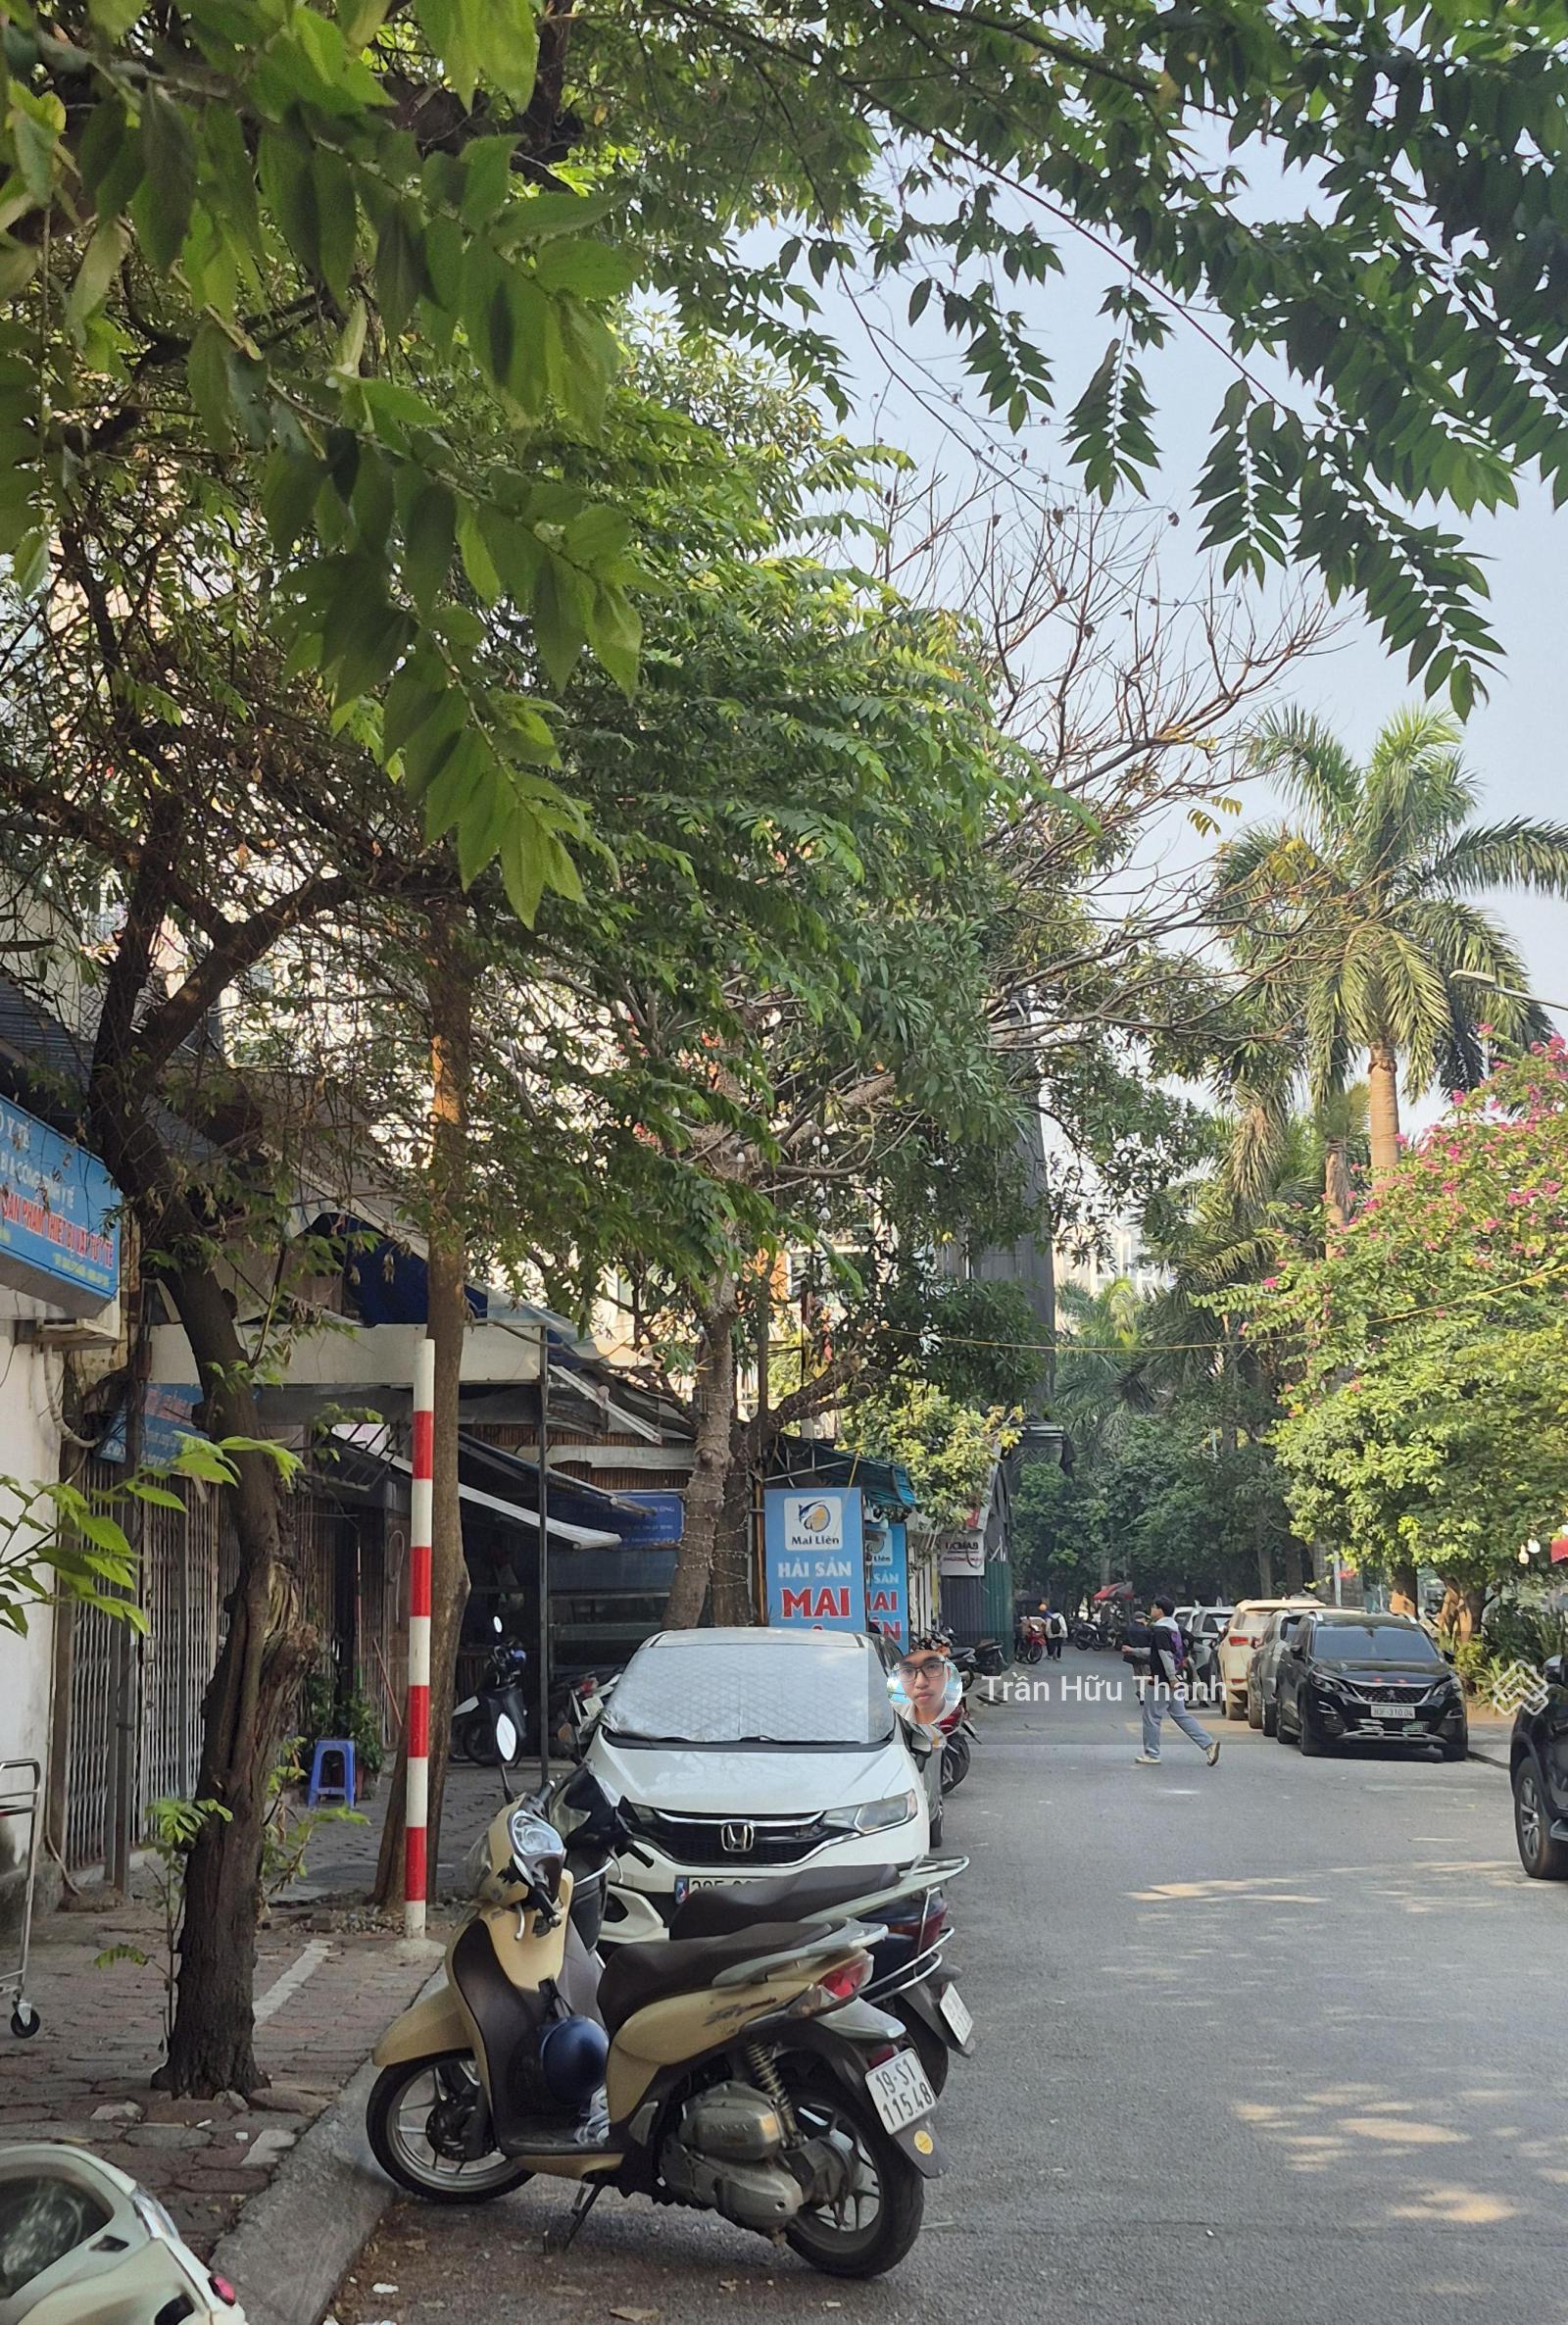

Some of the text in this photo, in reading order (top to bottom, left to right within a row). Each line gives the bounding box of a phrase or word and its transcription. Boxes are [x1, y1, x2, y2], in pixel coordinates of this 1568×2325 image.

[791, 1534, 840, 1546] Mai Liên
[777, 1557, 852, 1578] HẢI SẢN
[873, 1569, 899, 1584] SẢN
[780, 1587, 852, 1618] MAI
[875, 2058, 916, 2097] 19-S1
[883, 2082, 933, 2126] 115.48
